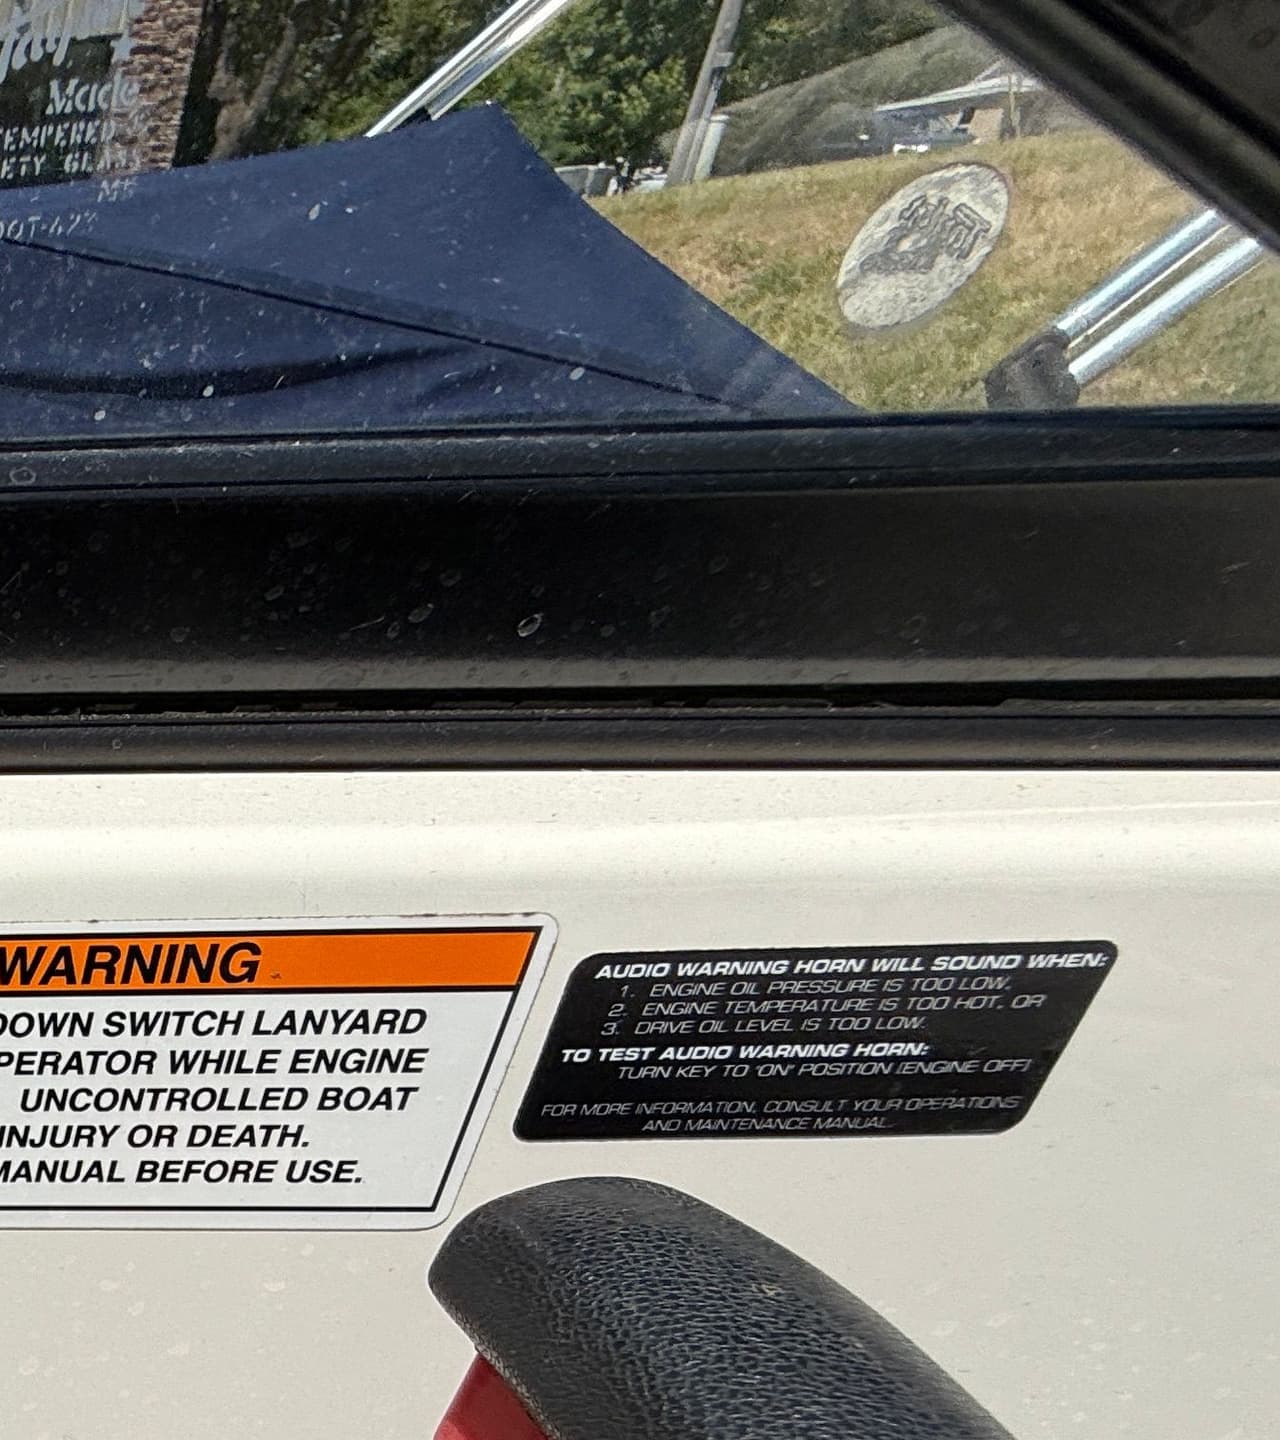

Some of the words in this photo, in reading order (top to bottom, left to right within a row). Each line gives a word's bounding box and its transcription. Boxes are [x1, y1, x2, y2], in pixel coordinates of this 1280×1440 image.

[595, 963, 671, 979] AUDIO
[677, 960, 790, 976] WARNING
[793, 959, 867, 973] HORN
[871, 957, 924, 972] WILL
[931, 955, 1022, 971] SOUND
[1027, 953, 1108, 968] WHEN:
[103, 1010, 245, 1037] SWITCH
[252, 1009, 427, 1035] LANYARD
[170, 1049, 282, 1074] WHILE
[288, 1048, 429, 1074] ENGINE
[562, 1049, 591, 1062] TO
[599, 1047, 656, 1061] TEST
[658, 1046, 733, 1060] AUDIO
[739, 1043, 850, 1058] WARNING
[853, 1043, 929, 1057] HORN:
[20, 1087, 308, 1112] UNCONTROLLED
[317, 1087, 419, 1111] BOAT
[127, 1124, 178, 1148] OR
[186, 1124, 309, 1147] DEATH.
[135, 1160, 278, 1183] BEFORE
[286, 1160, 362, 1183] USE.
